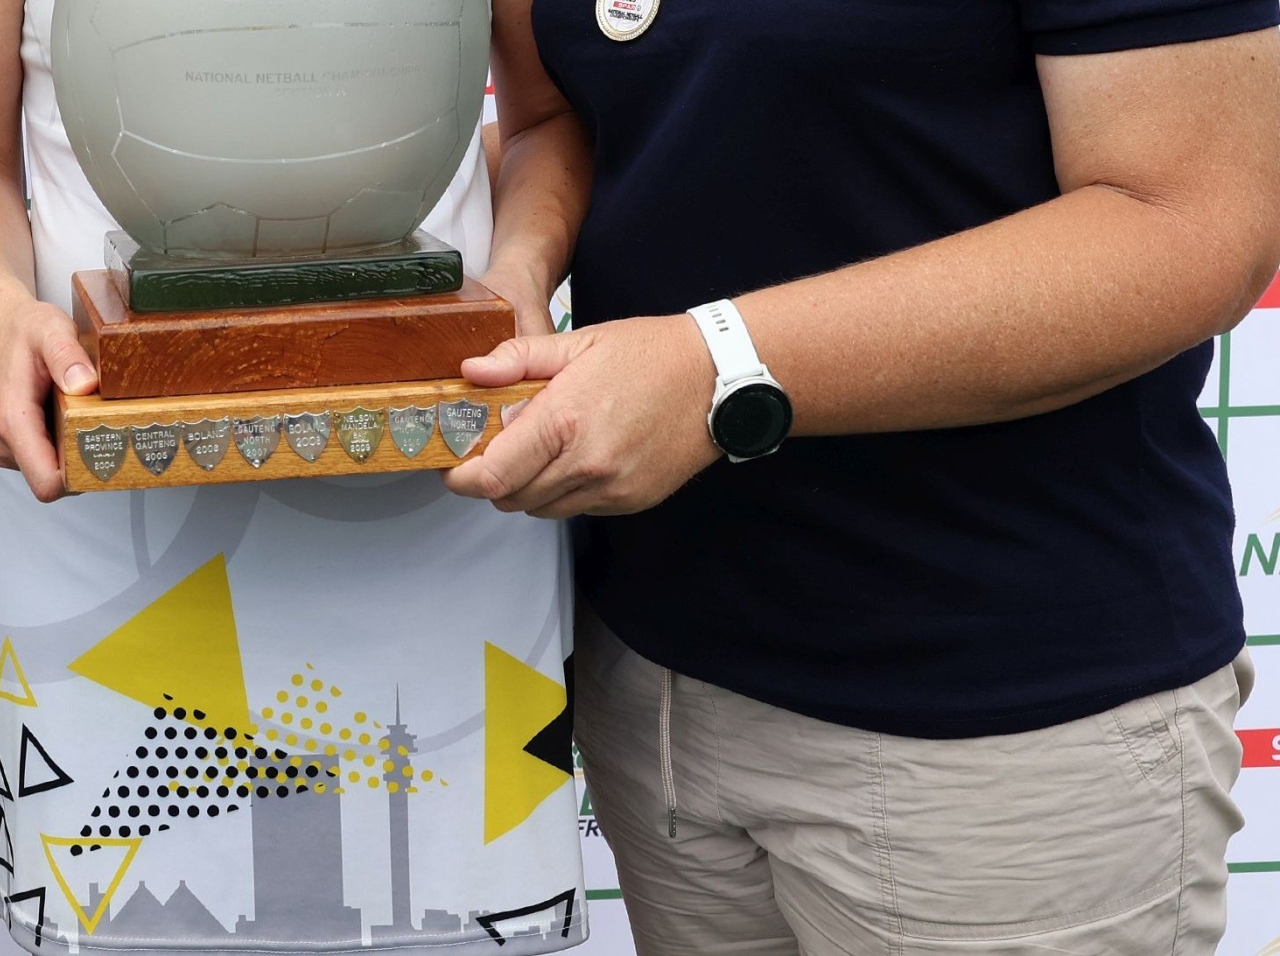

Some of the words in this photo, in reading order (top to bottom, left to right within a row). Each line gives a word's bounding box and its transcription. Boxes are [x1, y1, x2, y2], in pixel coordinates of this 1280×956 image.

[185, 70, 252, 85] NATIONAL
[256, 72, 317, 84] NETBALL
[446, 407, 482, 418] GAUTENG
[343, 414, 375, 423] NELSON
[237, 424, 276, 434] GAUTENG
[288, 422, 326, 435] BOLAND
[341, 421, 378, 431] MANDELA
[450, 420, 477, 430] NORTH
[84, 433, 122, 443] EASTERN
[135, 430, 175, 441] CENTRAL
[187, 429, 225, 441] BOLAND
[135, 439, 176, 450] GAUTENG
[243, 436, 271, 445] NORTH
[84, 441, 123, 451] PROVINCE
[145, 451, 168, 461] 2005
[246, 447, 268, 457] 2007
[94, 461, 116, 470] 2004
